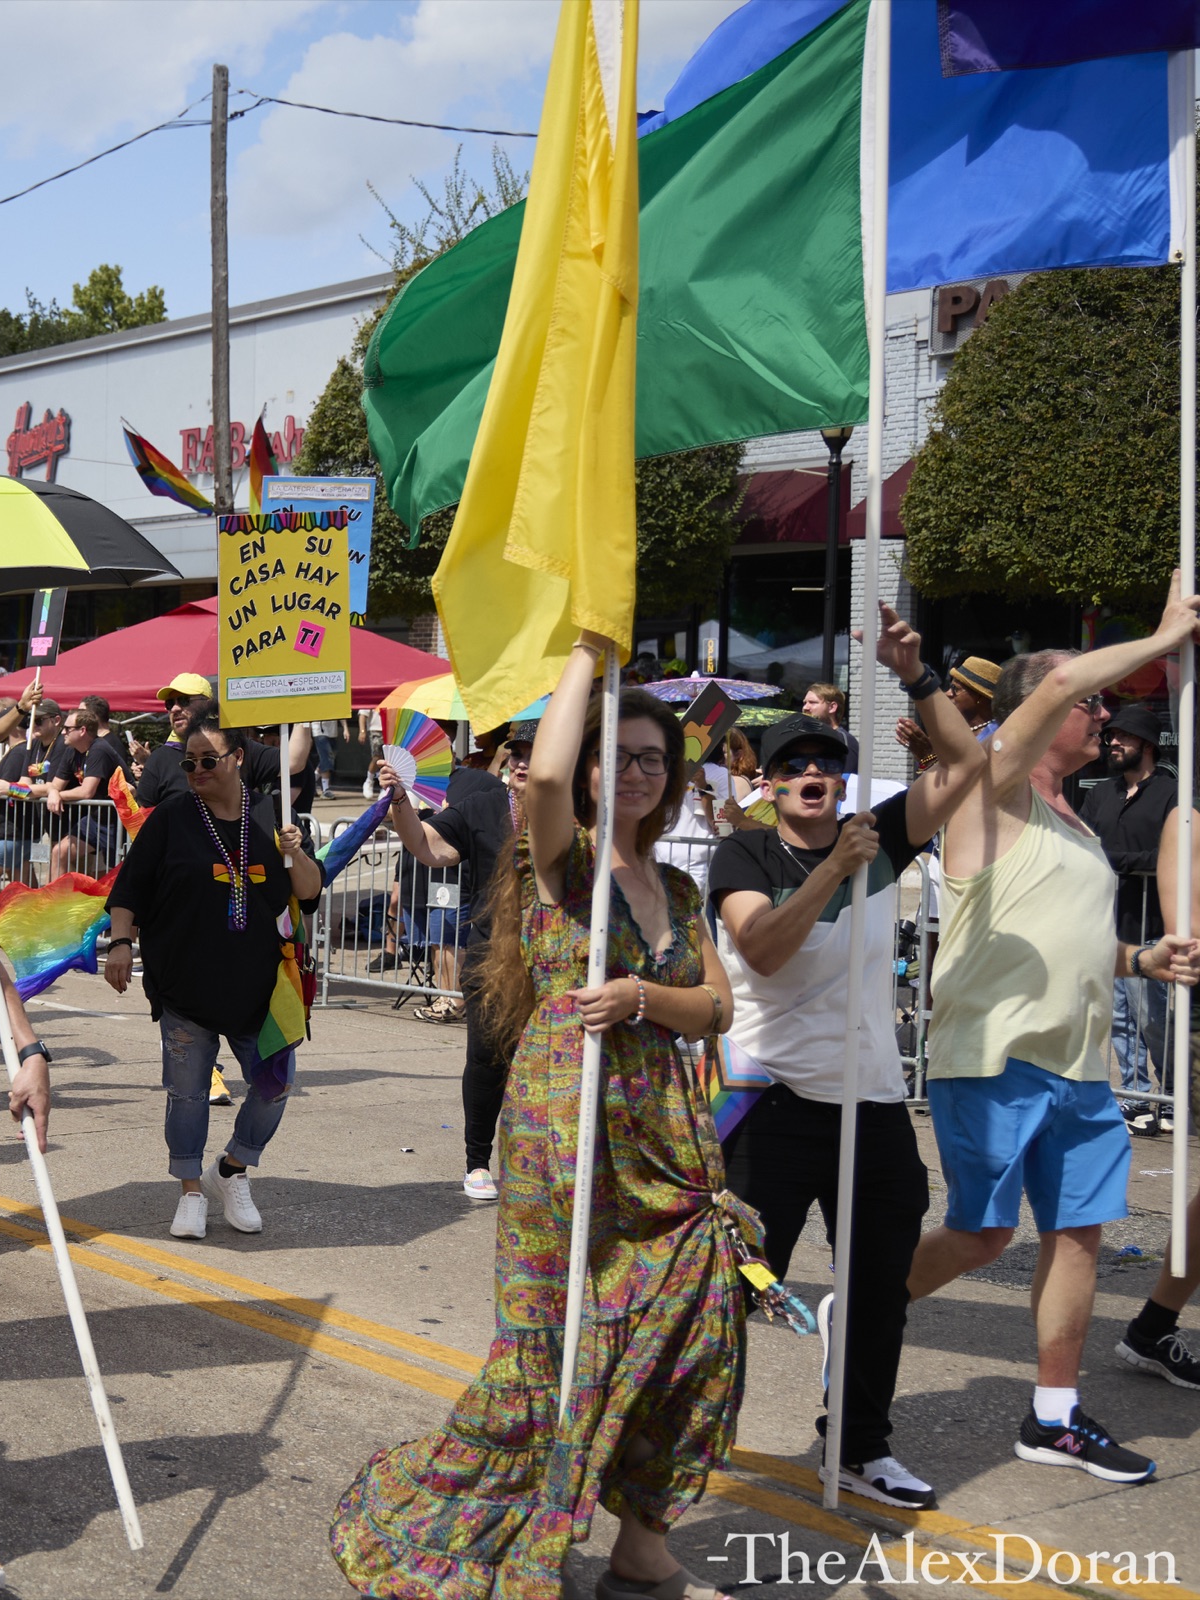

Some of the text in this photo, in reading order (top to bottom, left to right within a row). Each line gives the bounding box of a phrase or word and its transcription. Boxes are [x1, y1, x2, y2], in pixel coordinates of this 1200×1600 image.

[938, 279, 1010, 332] PA
[239, 536, 332, 564] EN SU
[229, 558, 339, 595] CASA HAY
[228, 591, 341, 631] UN LUGAR
[231, 625, 320, 665] PARA TI
[230, 675, 343, 690] LA CATEDRAL ESPERANZA
